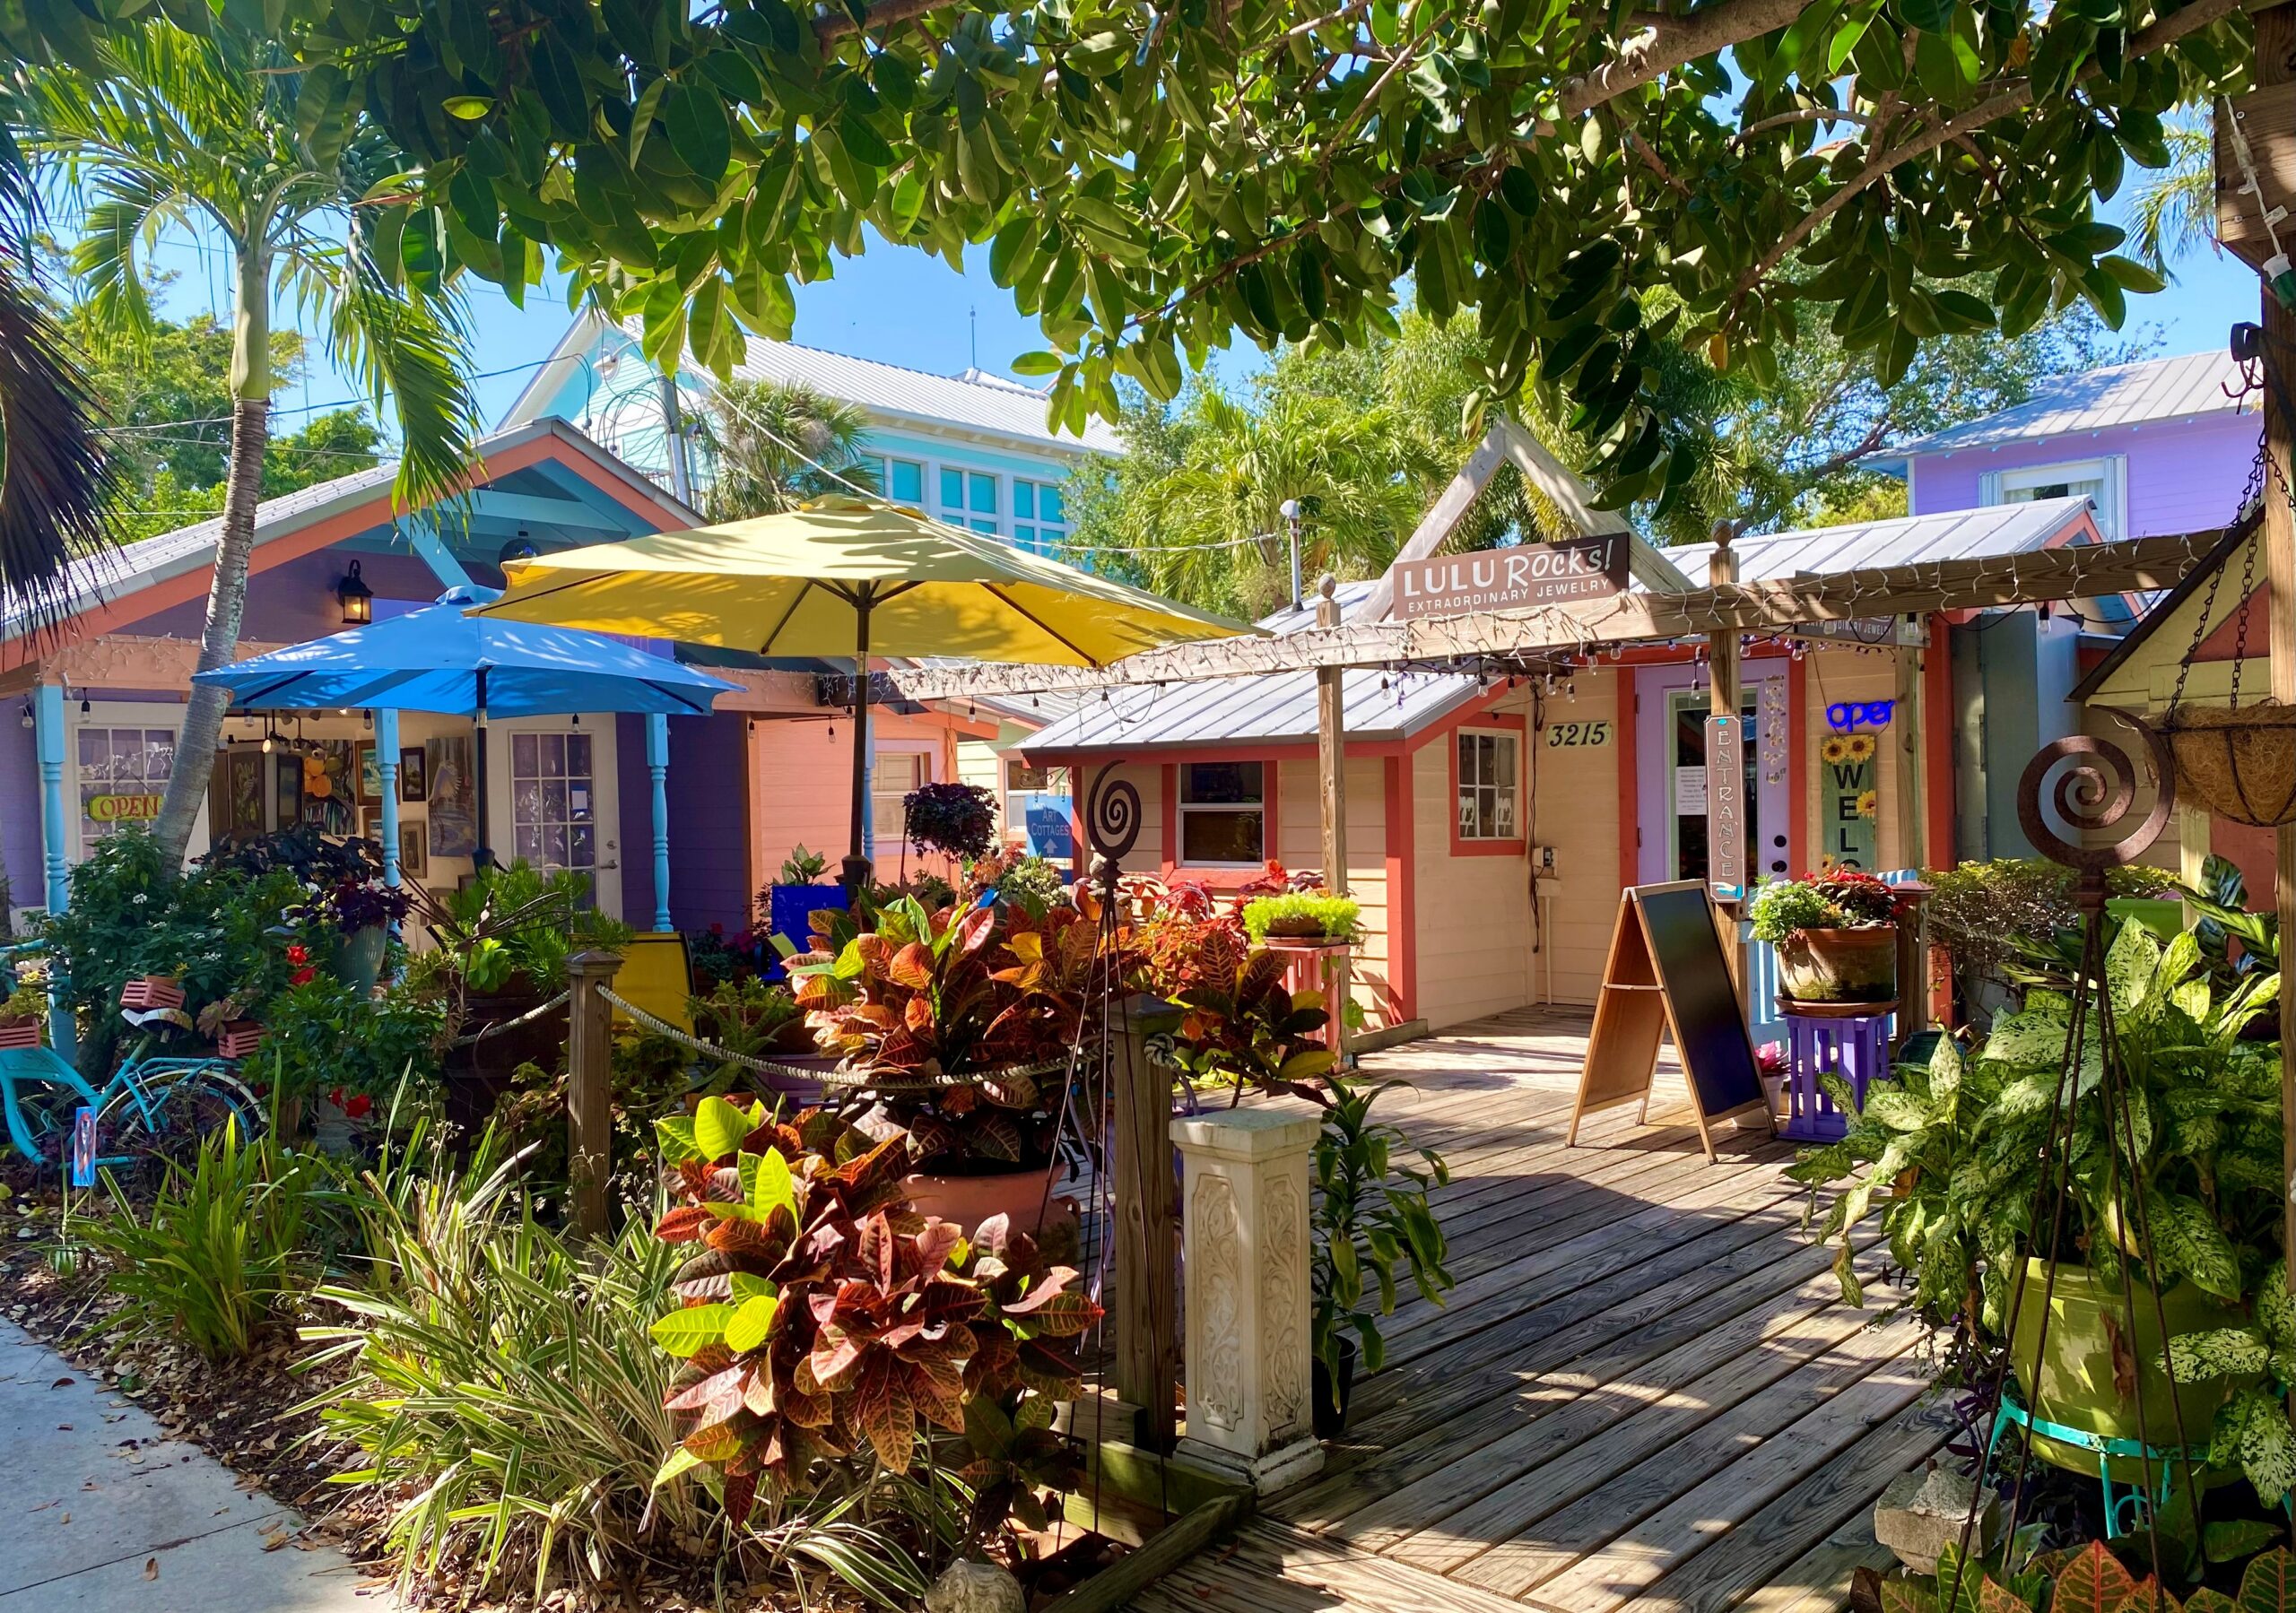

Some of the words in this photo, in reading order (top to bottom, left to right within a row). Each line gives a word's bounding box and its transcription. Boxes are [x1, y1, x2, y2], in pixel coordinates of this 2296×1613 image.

[1404, 559, 1495, 597] LULU
[1408, 587, 1529, 612] EXTRAORDINARY
[1536, 578, 1609, 598] JEWELRY
[1550, 723, 1607, 747] 3215
[100, 795, 159, 817] OPEN
[1042, 806, 1057, 822] ART
[1716, 731, 1735, 877] ENTRANCE
[1031, 822, 1069, 837] COTTAGES
